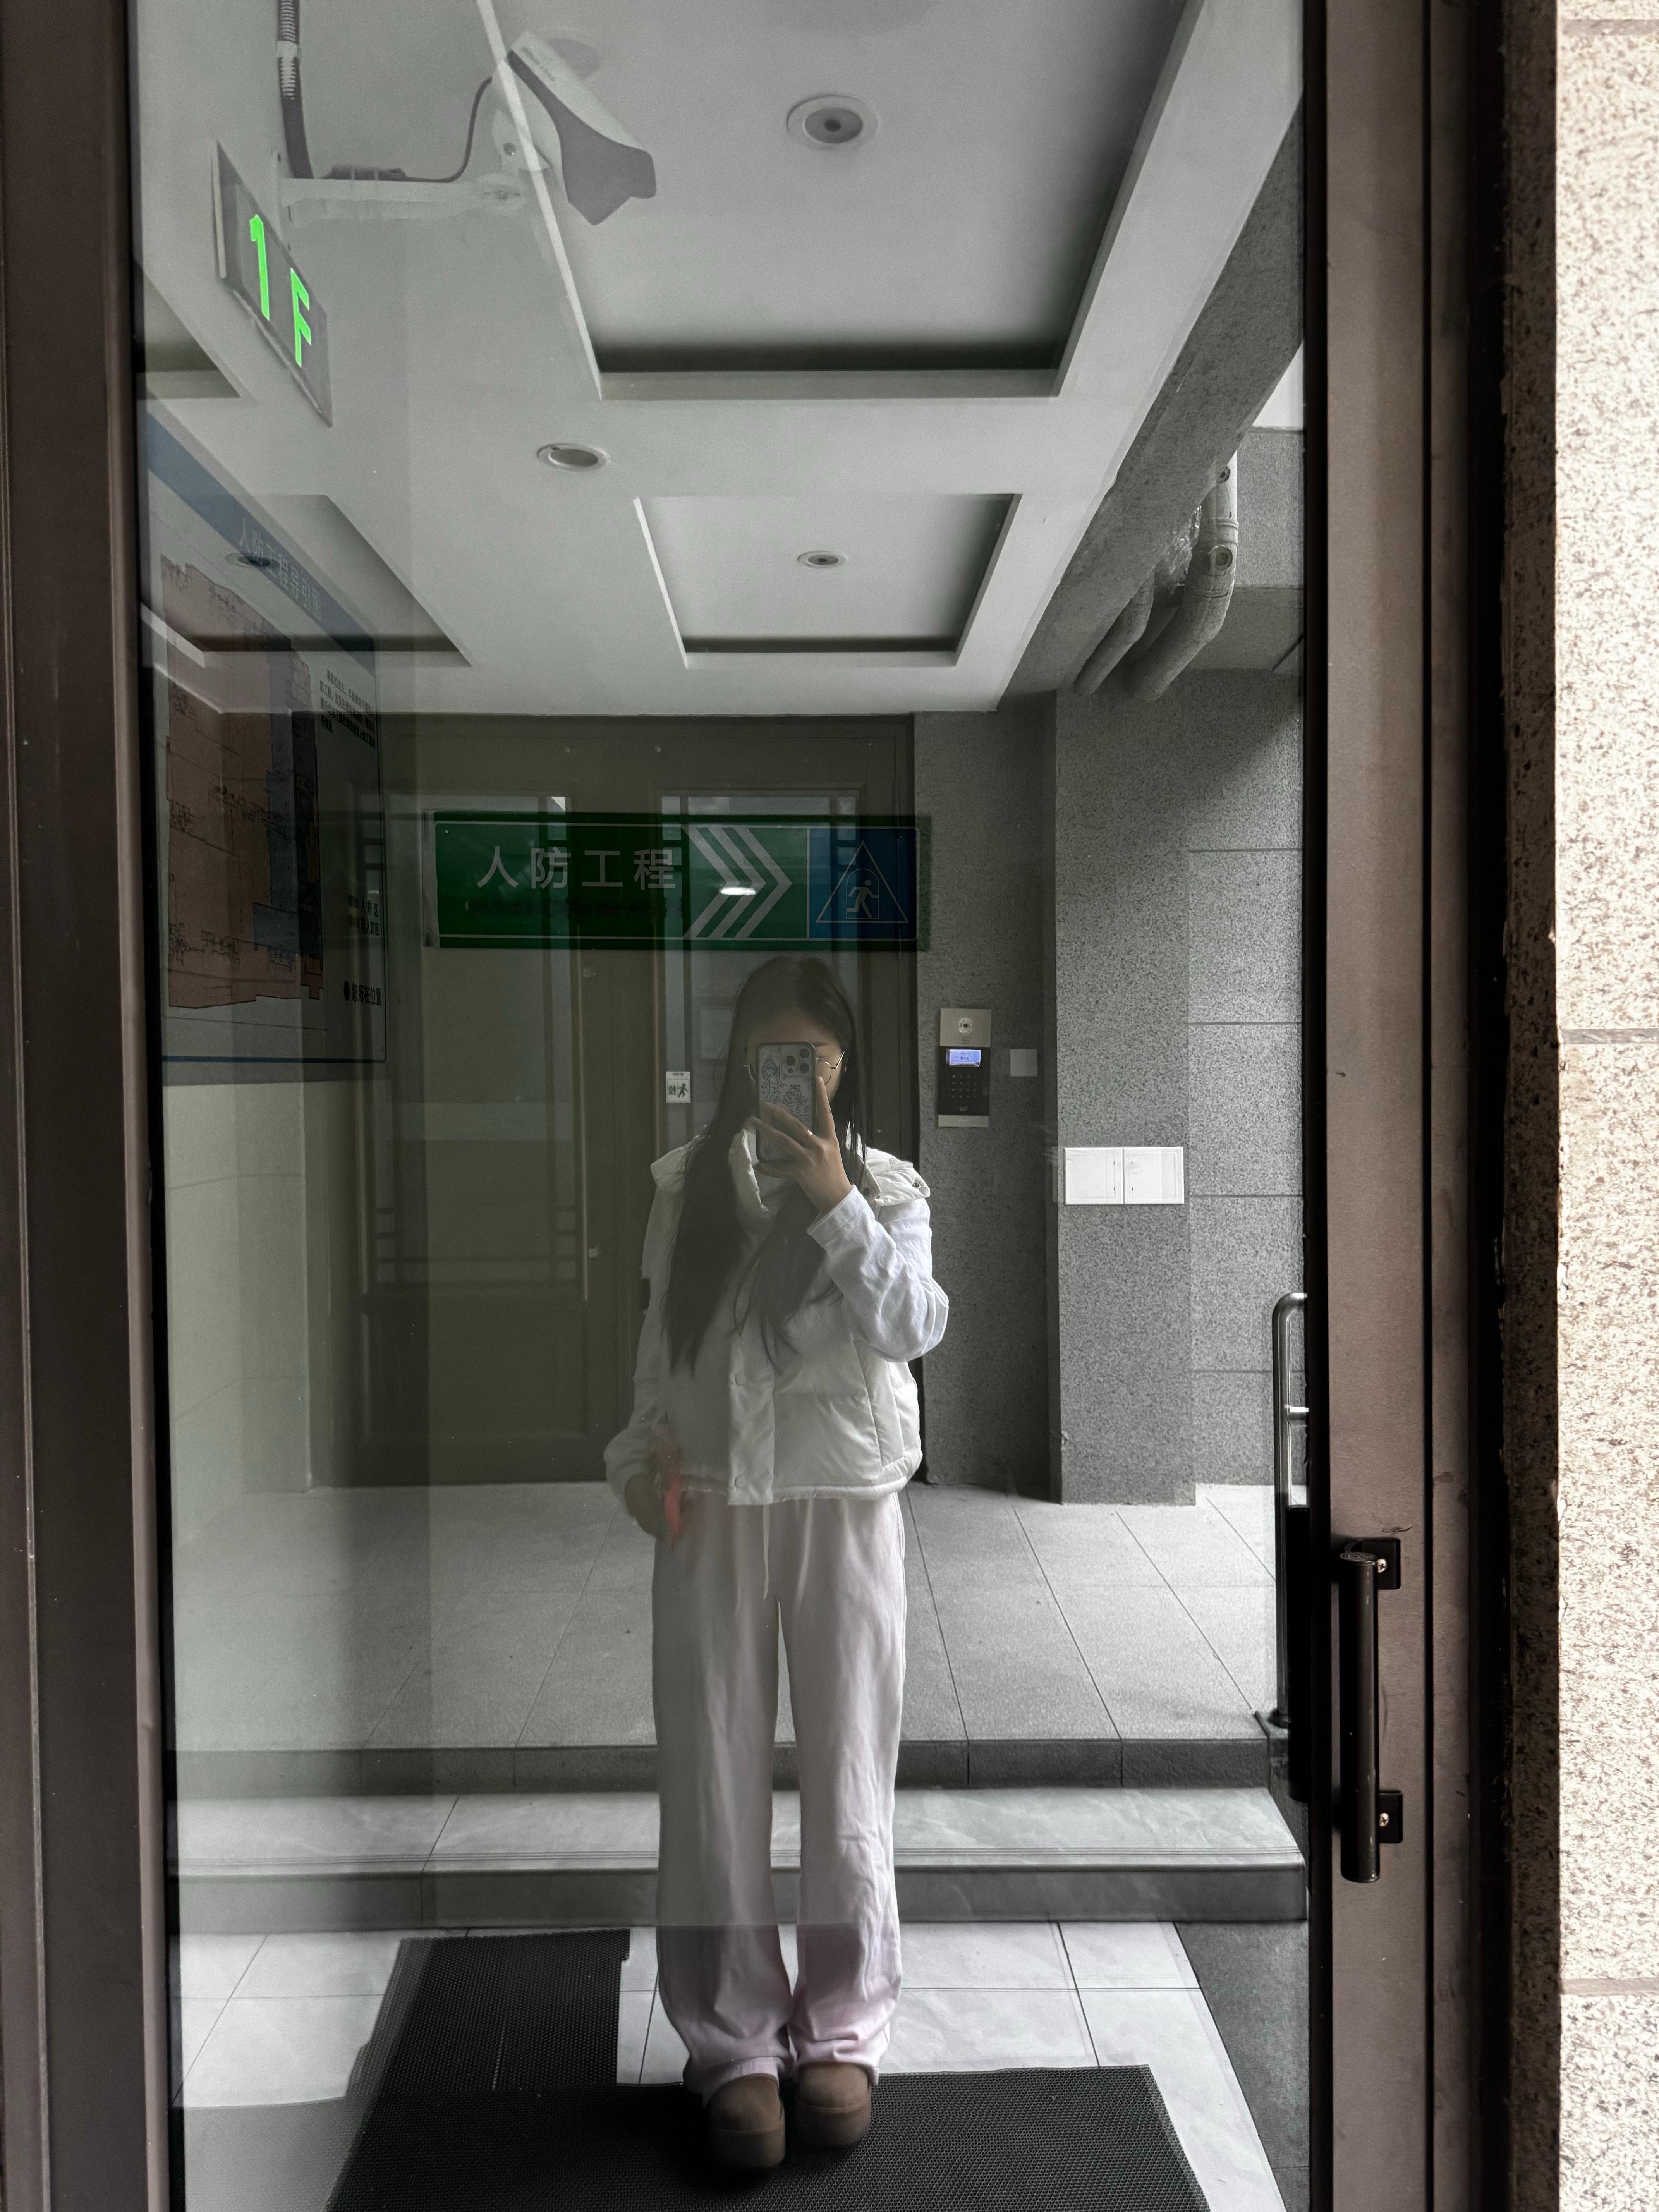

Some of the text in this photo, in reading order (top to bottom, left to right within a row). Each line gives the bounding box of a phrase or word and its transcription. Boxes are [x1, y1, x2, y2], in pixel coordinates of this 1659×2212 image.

[250, 215, 311, 368] 1F
[477, 846, 676, 891] 人防工程
[352, 982, 381, 1006] 您所在位置
